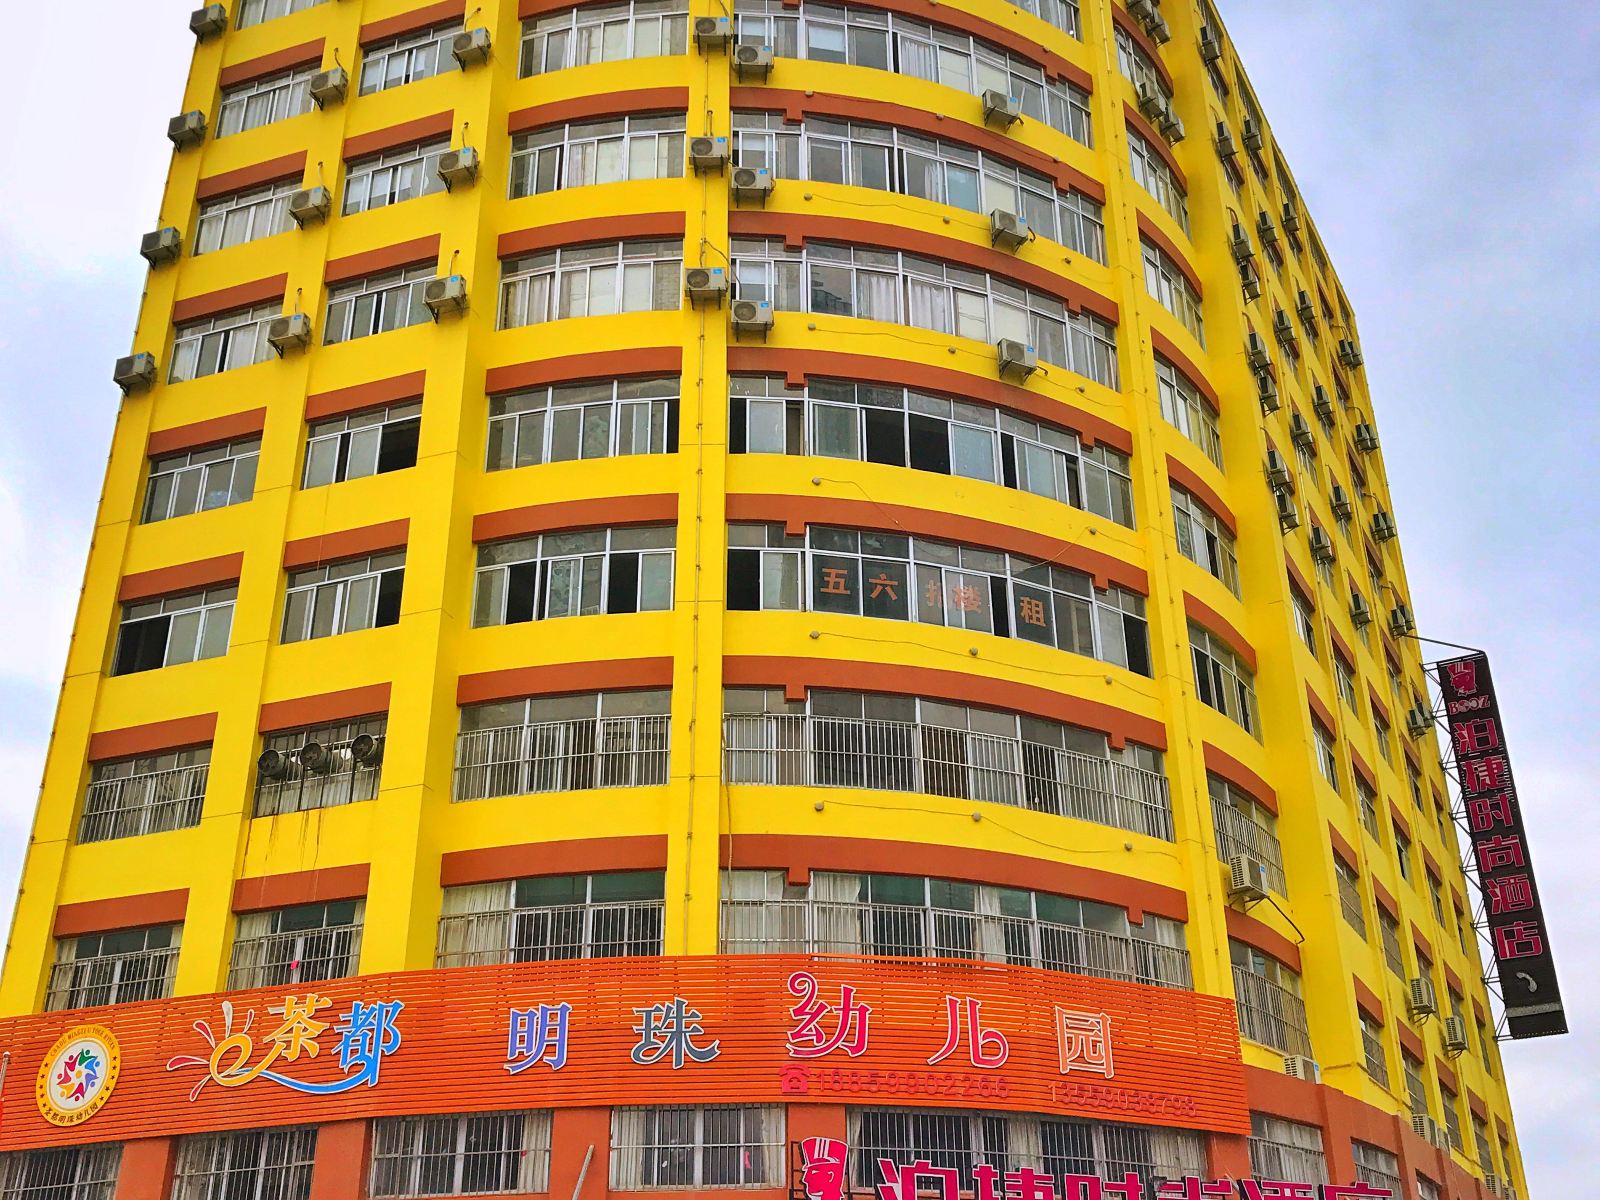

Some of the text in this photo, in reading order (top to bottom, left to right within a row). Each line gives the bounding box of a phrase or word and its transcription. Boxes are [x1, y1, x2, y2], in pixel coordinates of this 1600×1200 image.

[1453, 718, 1543, 960] 泊捷时尚酒店
